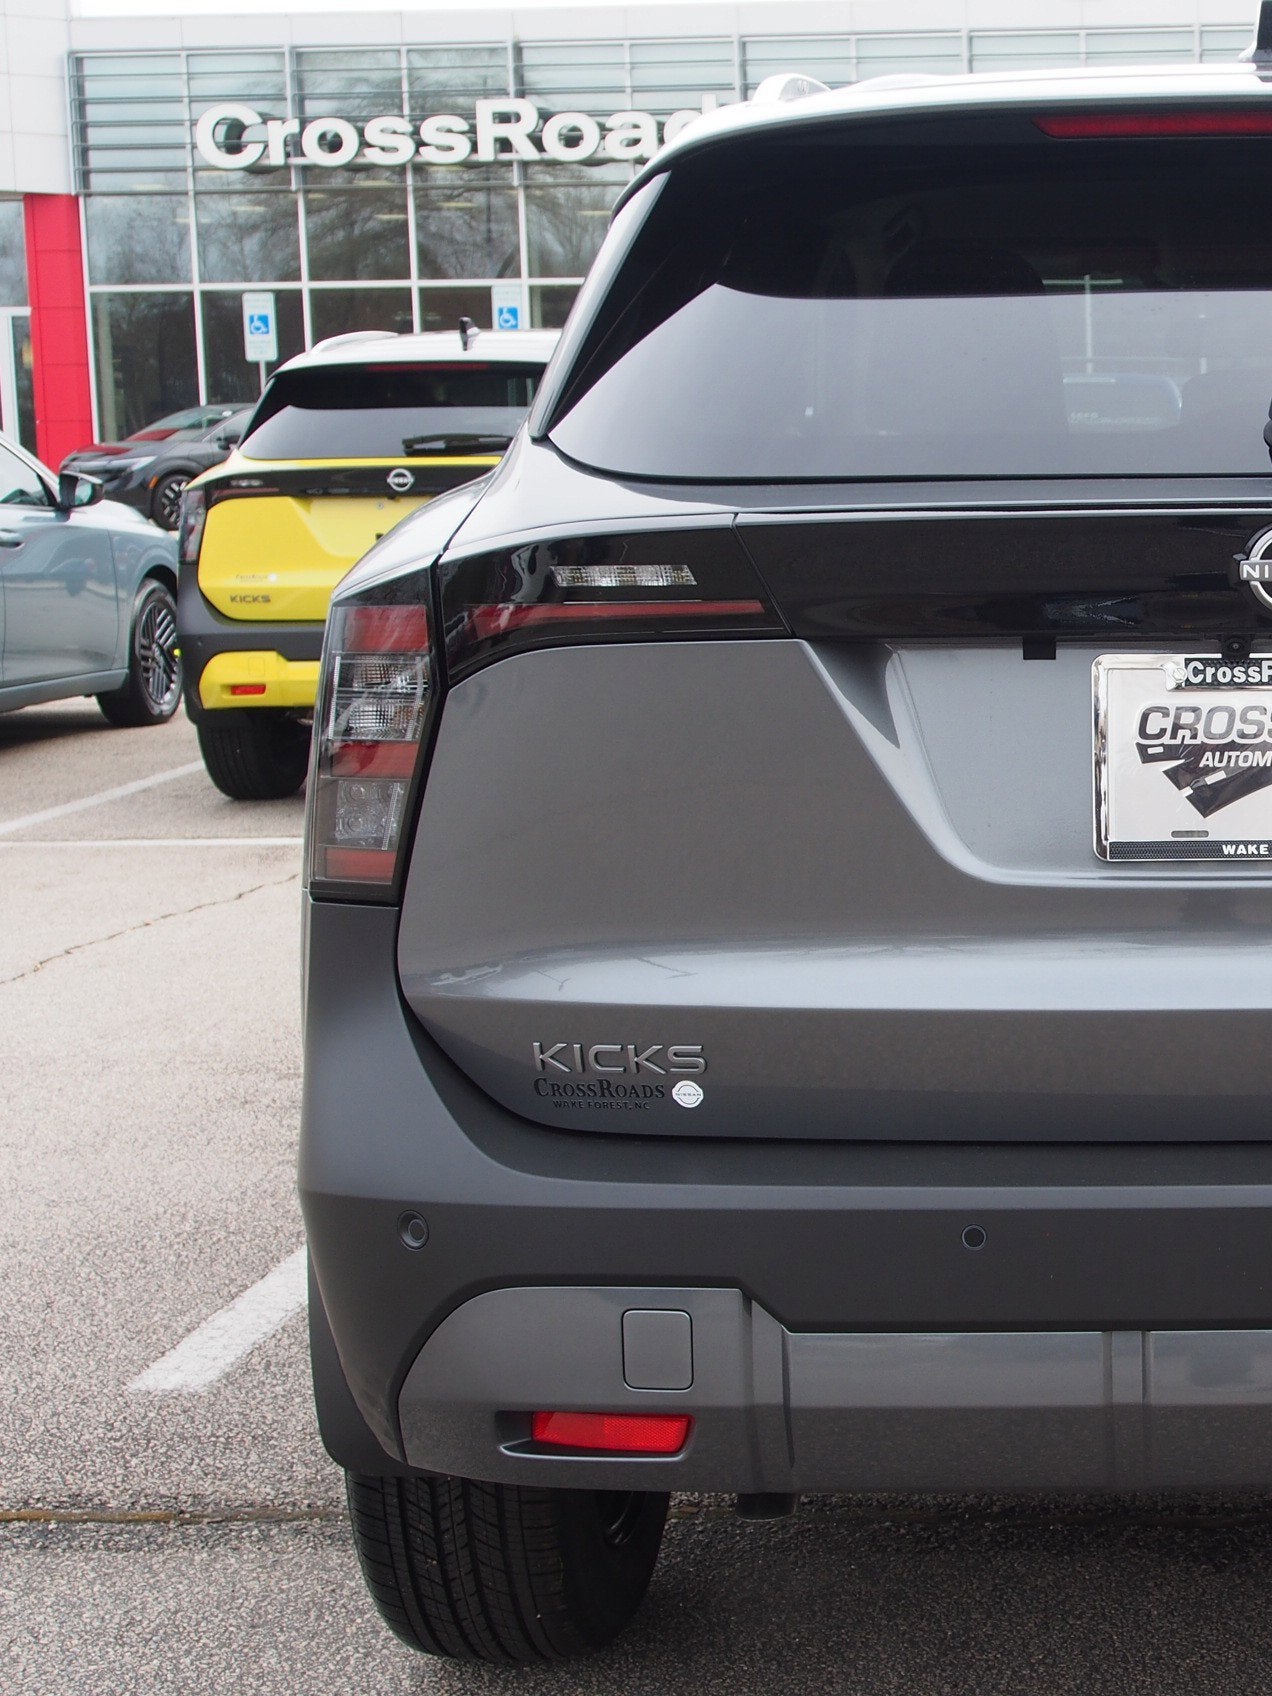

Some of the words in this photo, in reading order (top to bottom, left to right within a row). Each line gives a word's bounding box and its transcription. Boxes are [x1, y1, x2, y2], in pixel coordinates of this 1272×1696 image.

[230, 594, 271, 604] KICKS
[1222, 844, 1269, 854] WAKE
[532, 1042, 706, 1074] KICKS
[553, 1100, 584, 1109] WAKE
[635, 1101, 650, 1109] NC
